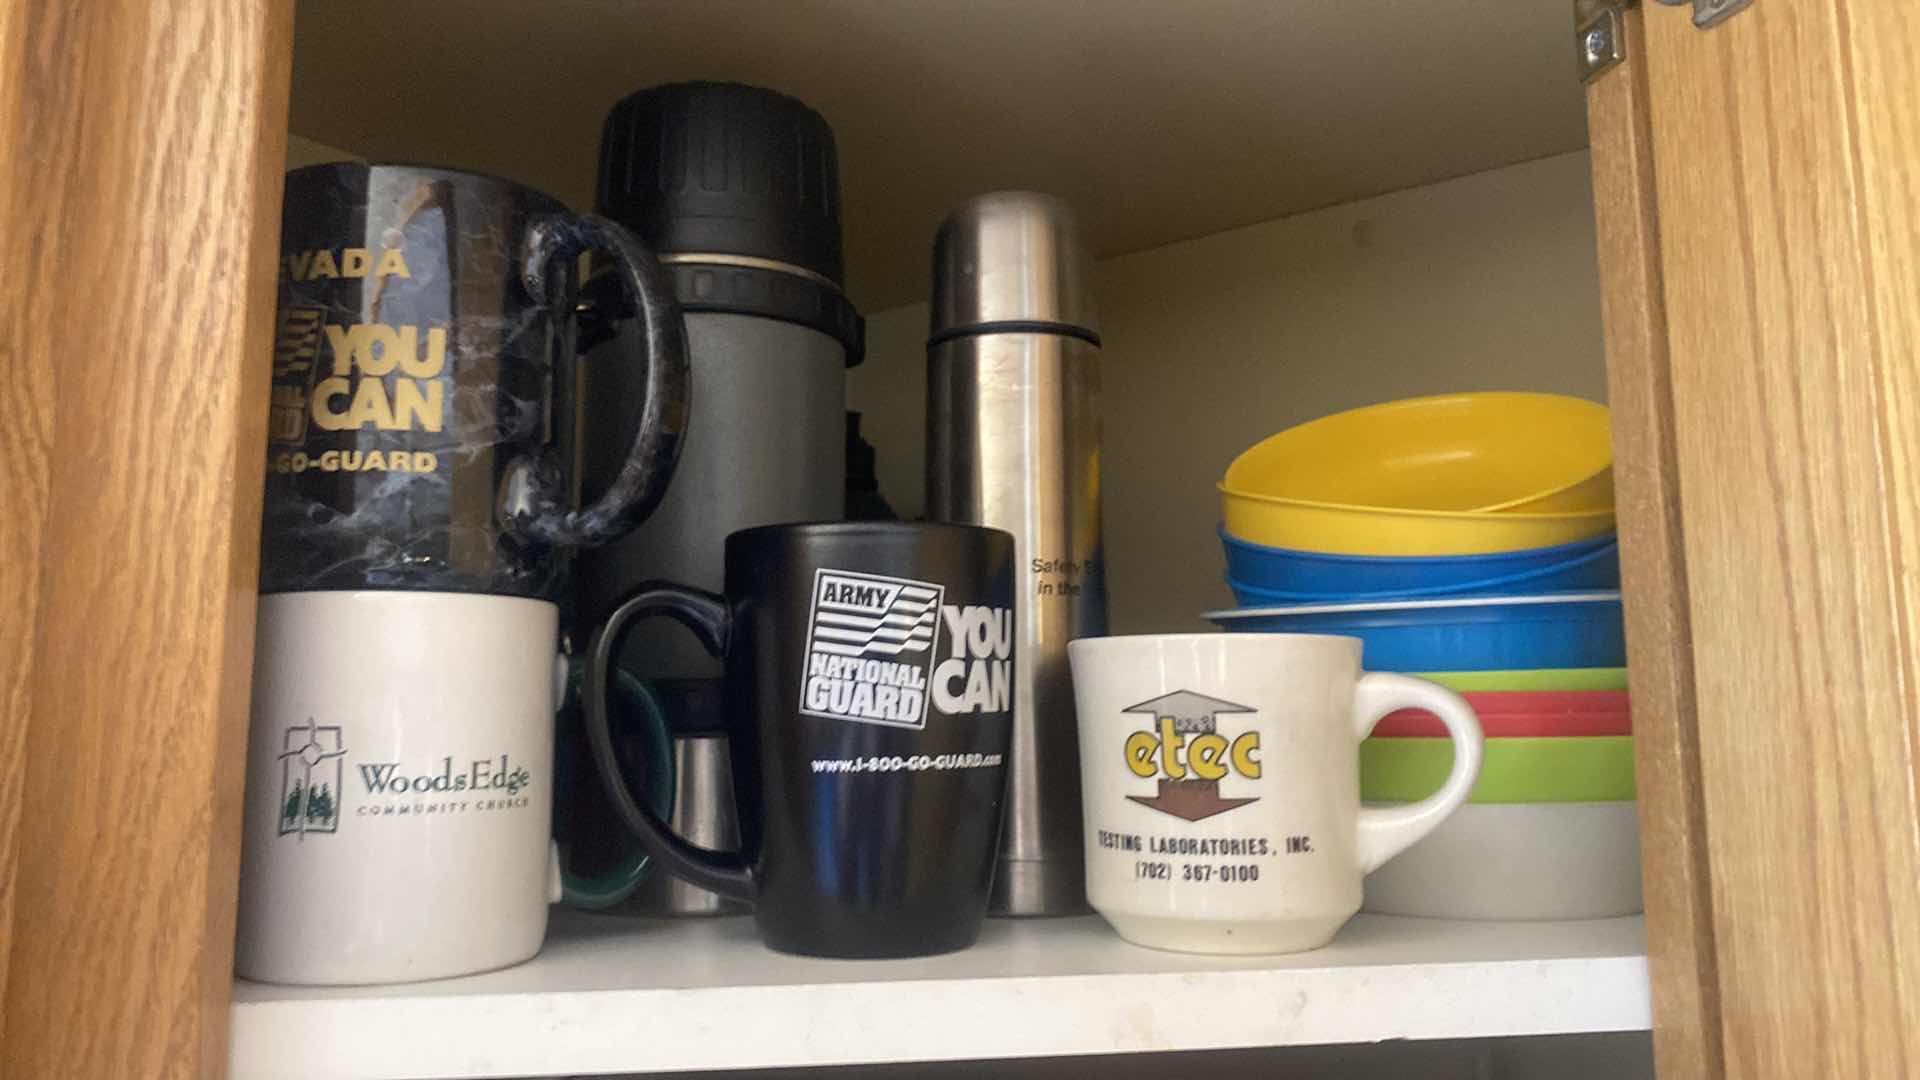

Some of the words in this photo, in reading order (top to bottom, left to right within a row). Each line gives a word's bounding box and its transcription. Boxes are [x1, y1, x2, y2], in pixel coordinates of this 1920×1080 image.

[280, 248, 410, 278] VADA
[324, 324, 446, 378] YOU
[312, 376, 444, 433] CAN
[822, 582, 891, 609] ARMY
[1038, 581, 1053, 595] in
[942, 604, 1012, 660] YOU
[808, 652, 926, 690] NATIONAL
[931, 658, 1011, 716] CAN
[807, 676, 924, 723] GUARD
[1124, 715, 1262, 780] etec
[357, 755, 530, 795] WoodsEdge
[357, 803, 468, 817] COMMUNITY
[475, 797, 530, 811] CHURCH
[1098, 830, 1142, 852] TESTING
[1286, 836, 1315, 853] INC.
[1135, 861, 1172, 881] (702)
[1183, 863, 1260, 882] 367-0100
